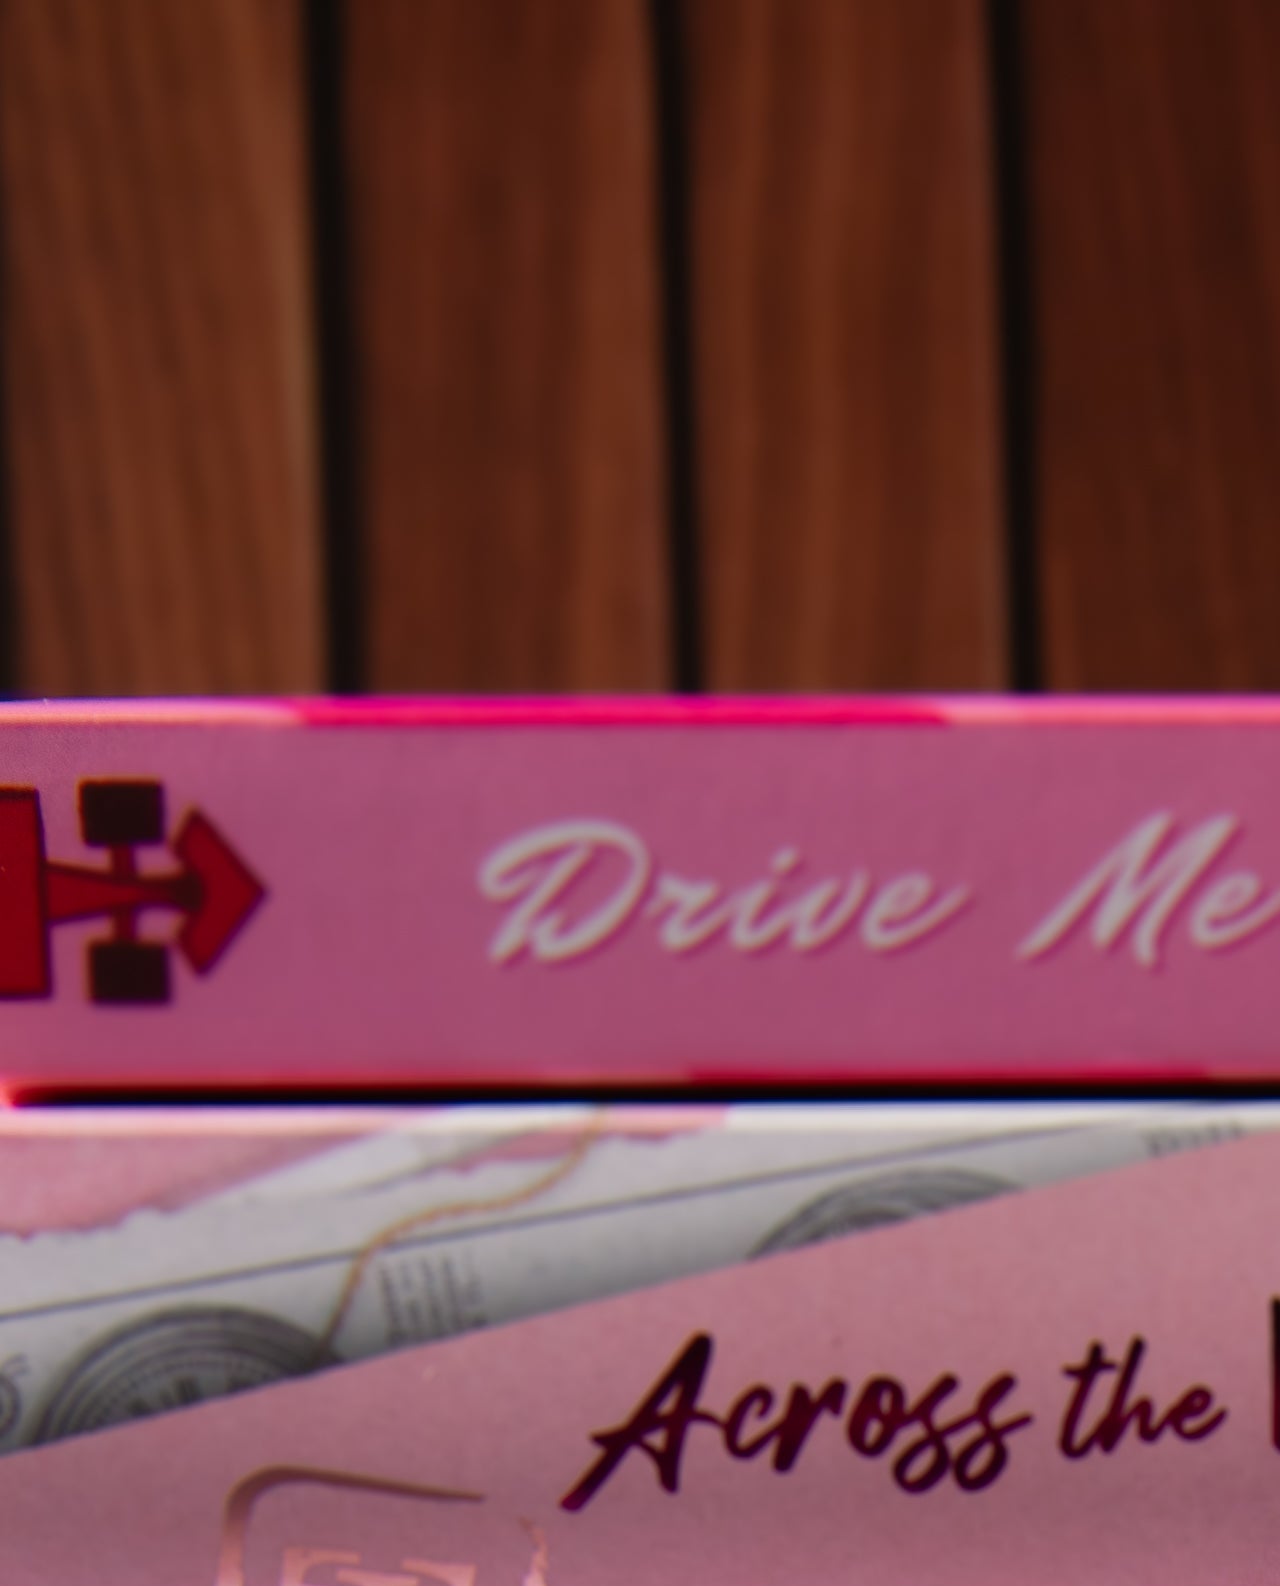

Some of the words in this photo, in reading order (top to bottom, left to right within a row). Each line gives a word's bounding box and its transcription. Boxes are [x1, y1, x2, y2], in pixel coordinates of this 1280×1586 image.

[478, 820, 970, 966] Drive
[560, 1332, 1032, 1512] Across
[1057, 1334, 1228, 1460] the
